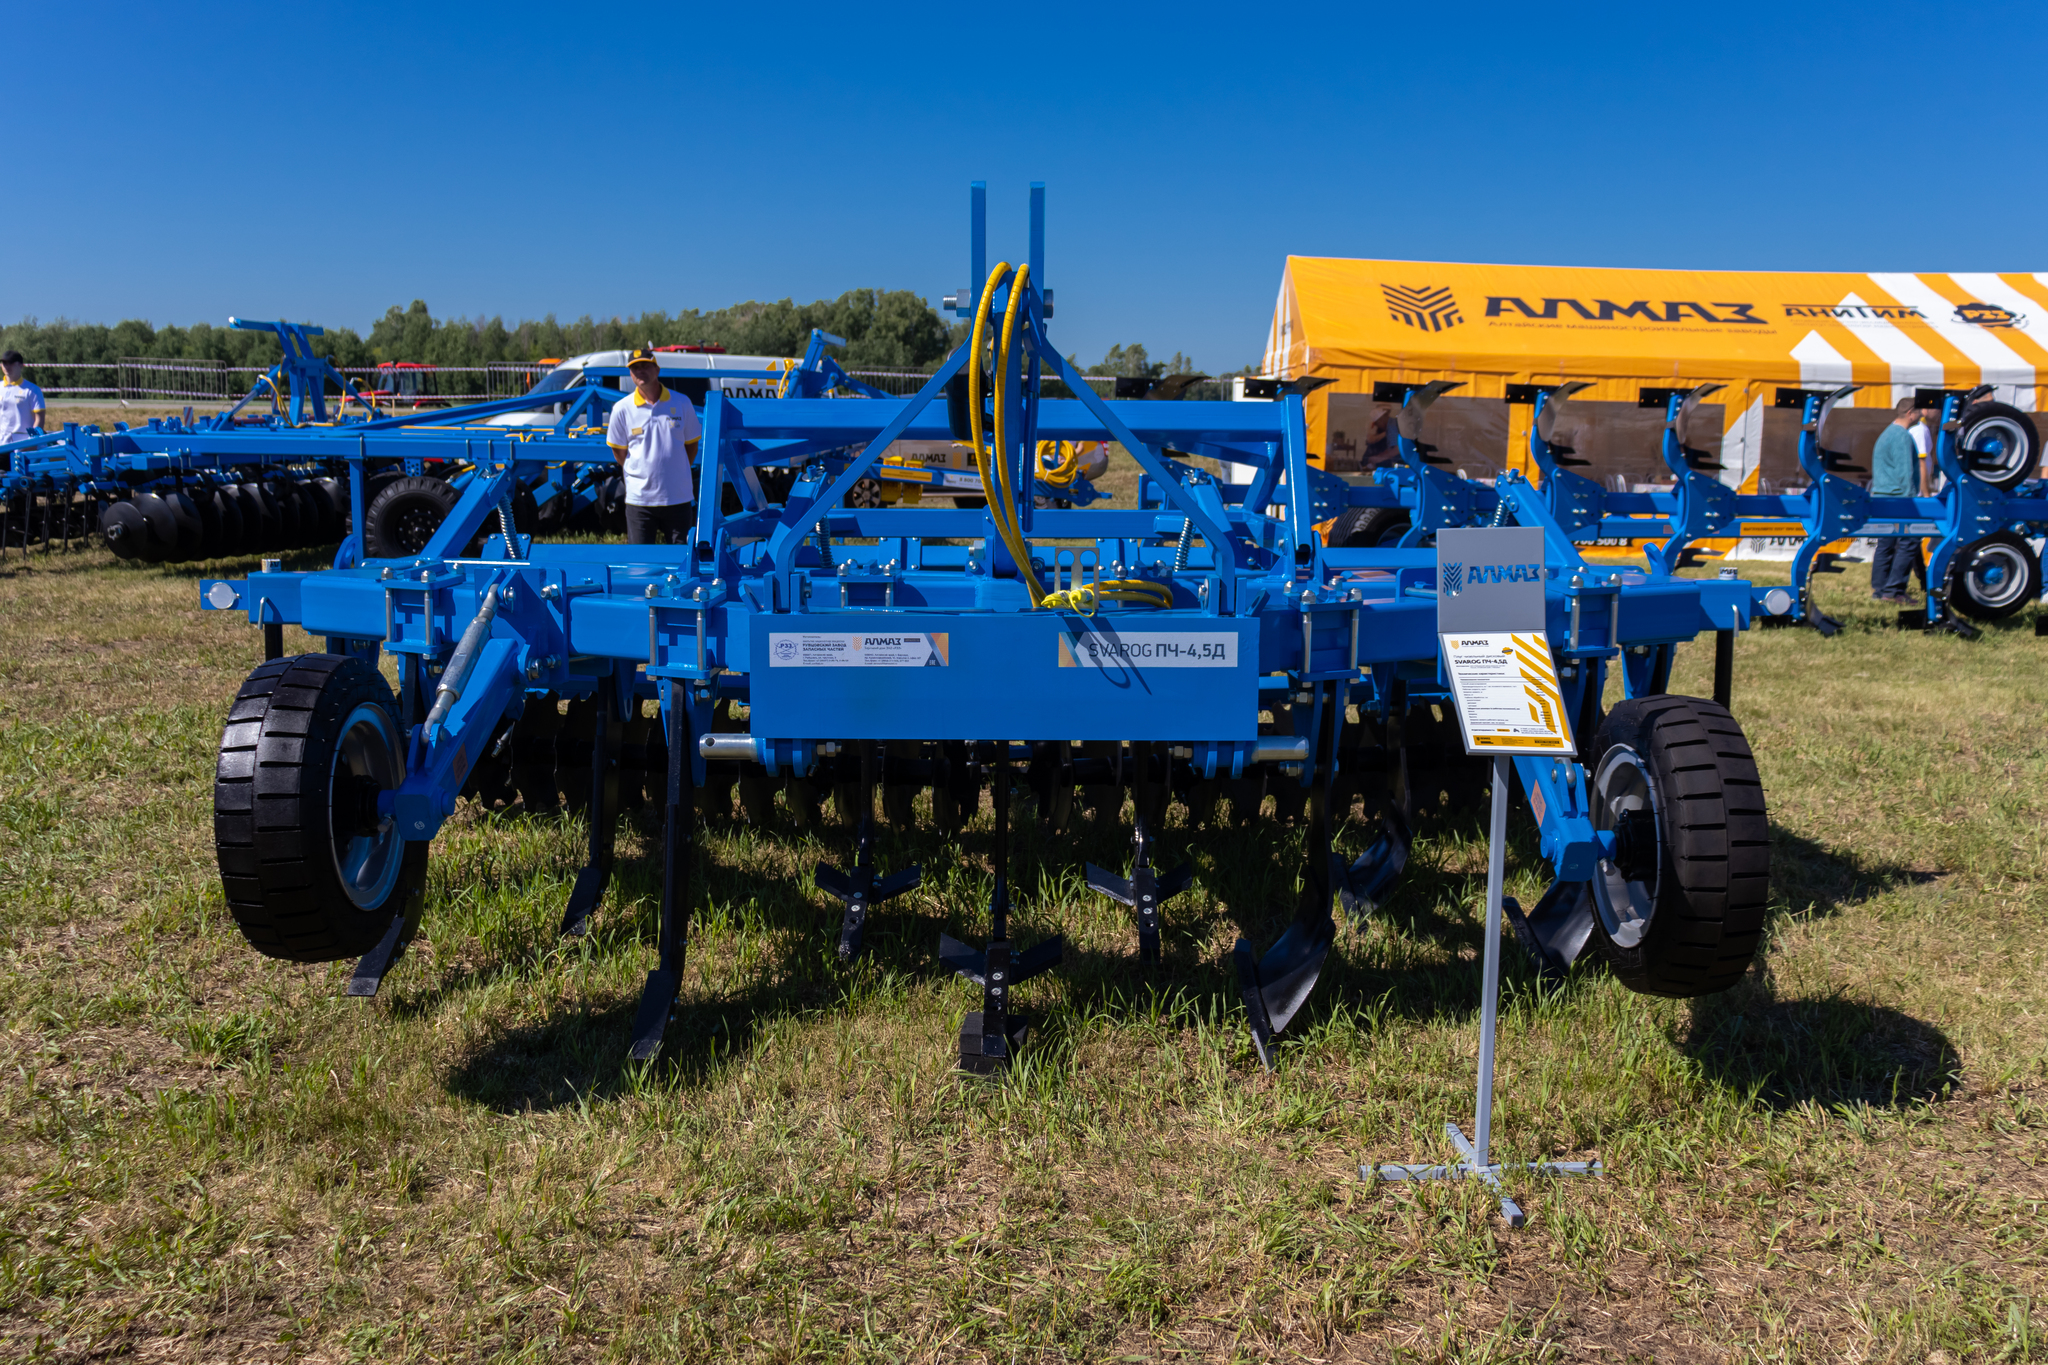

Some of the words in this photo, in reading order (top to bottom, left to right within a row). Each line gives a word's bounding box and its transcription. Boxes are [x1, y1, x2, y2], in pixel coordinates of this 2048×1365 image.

[1484, 296, 1769, 324] АЛМАЗ
[1488, 321, 1563, 329] Алтайские
[723, 387, 783, 398] АЛМА
[1467, 564, 1540, 584] АЛМАЗ
[1088, 643, 1152, 657] SVAROG
[1156, 643, 1225, 660] ПЧ-4,5Д
